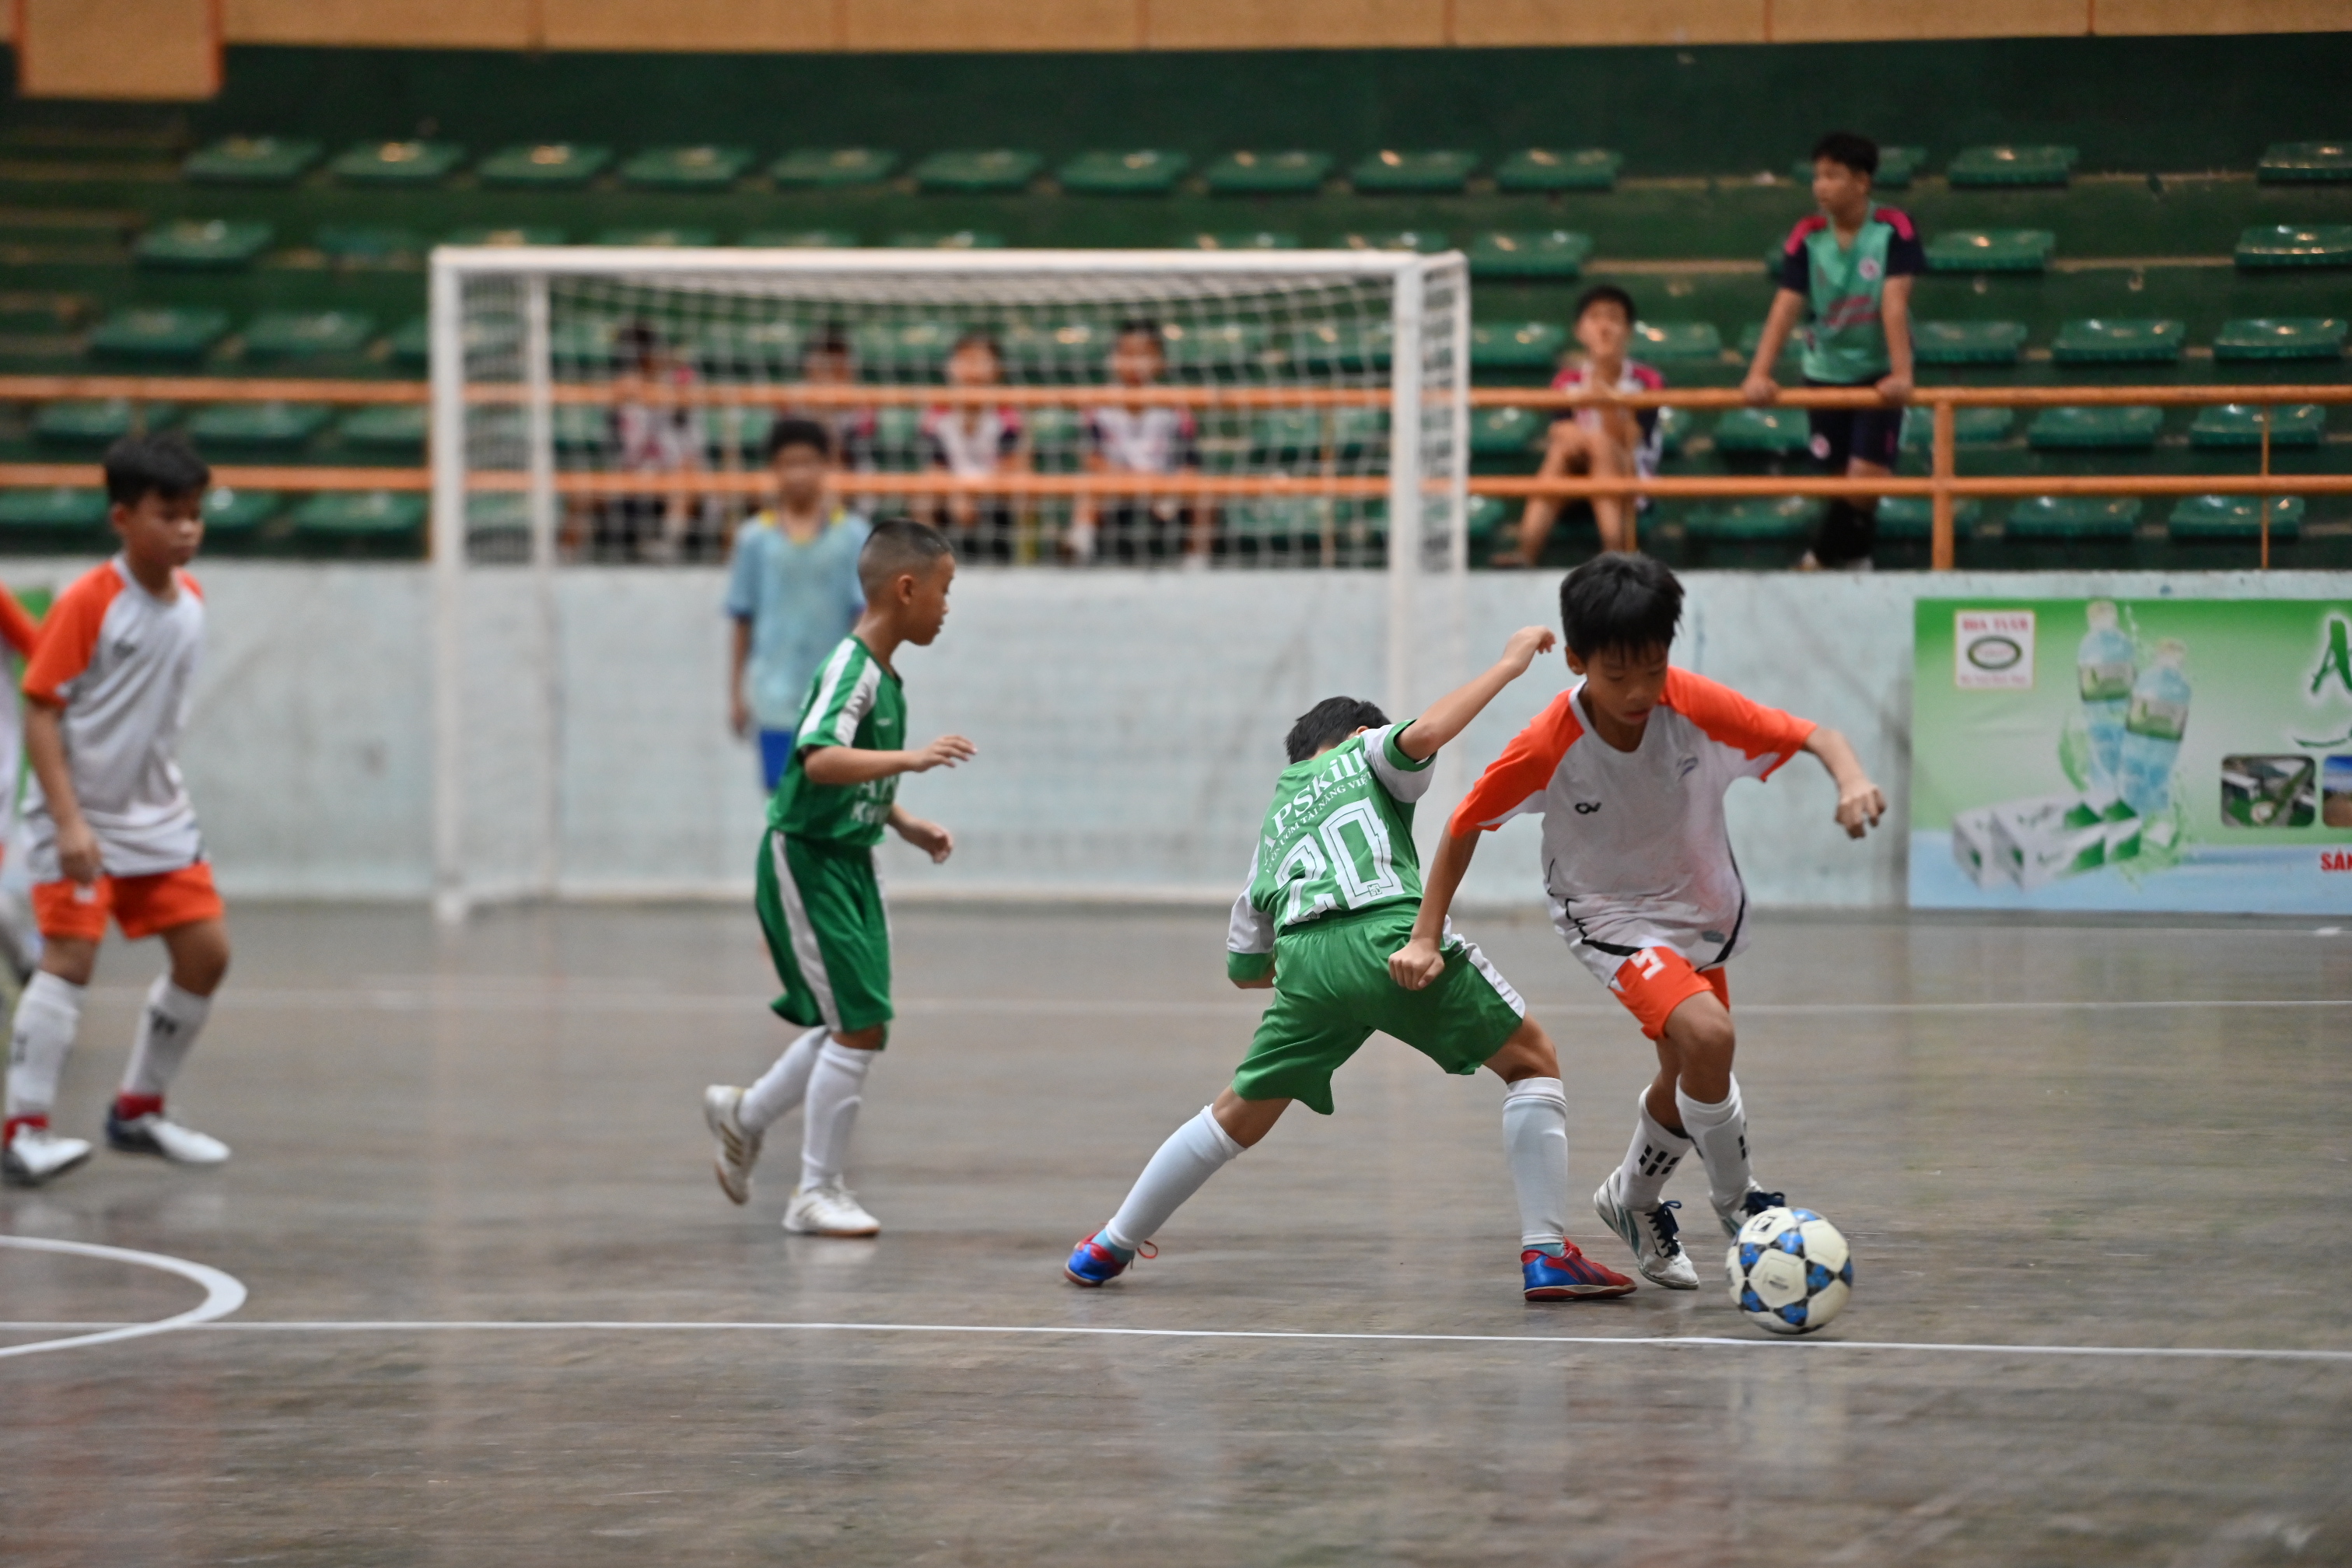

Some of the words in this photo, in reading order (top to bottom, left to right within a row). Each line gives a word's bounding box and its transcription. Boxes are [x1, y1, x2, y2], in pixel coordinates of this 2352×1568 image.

[1300, 809, 1319, 824] TÀI
[1318, 785, 1346, 810] NĂNG
[1275, 796, 1405, 926] 20
